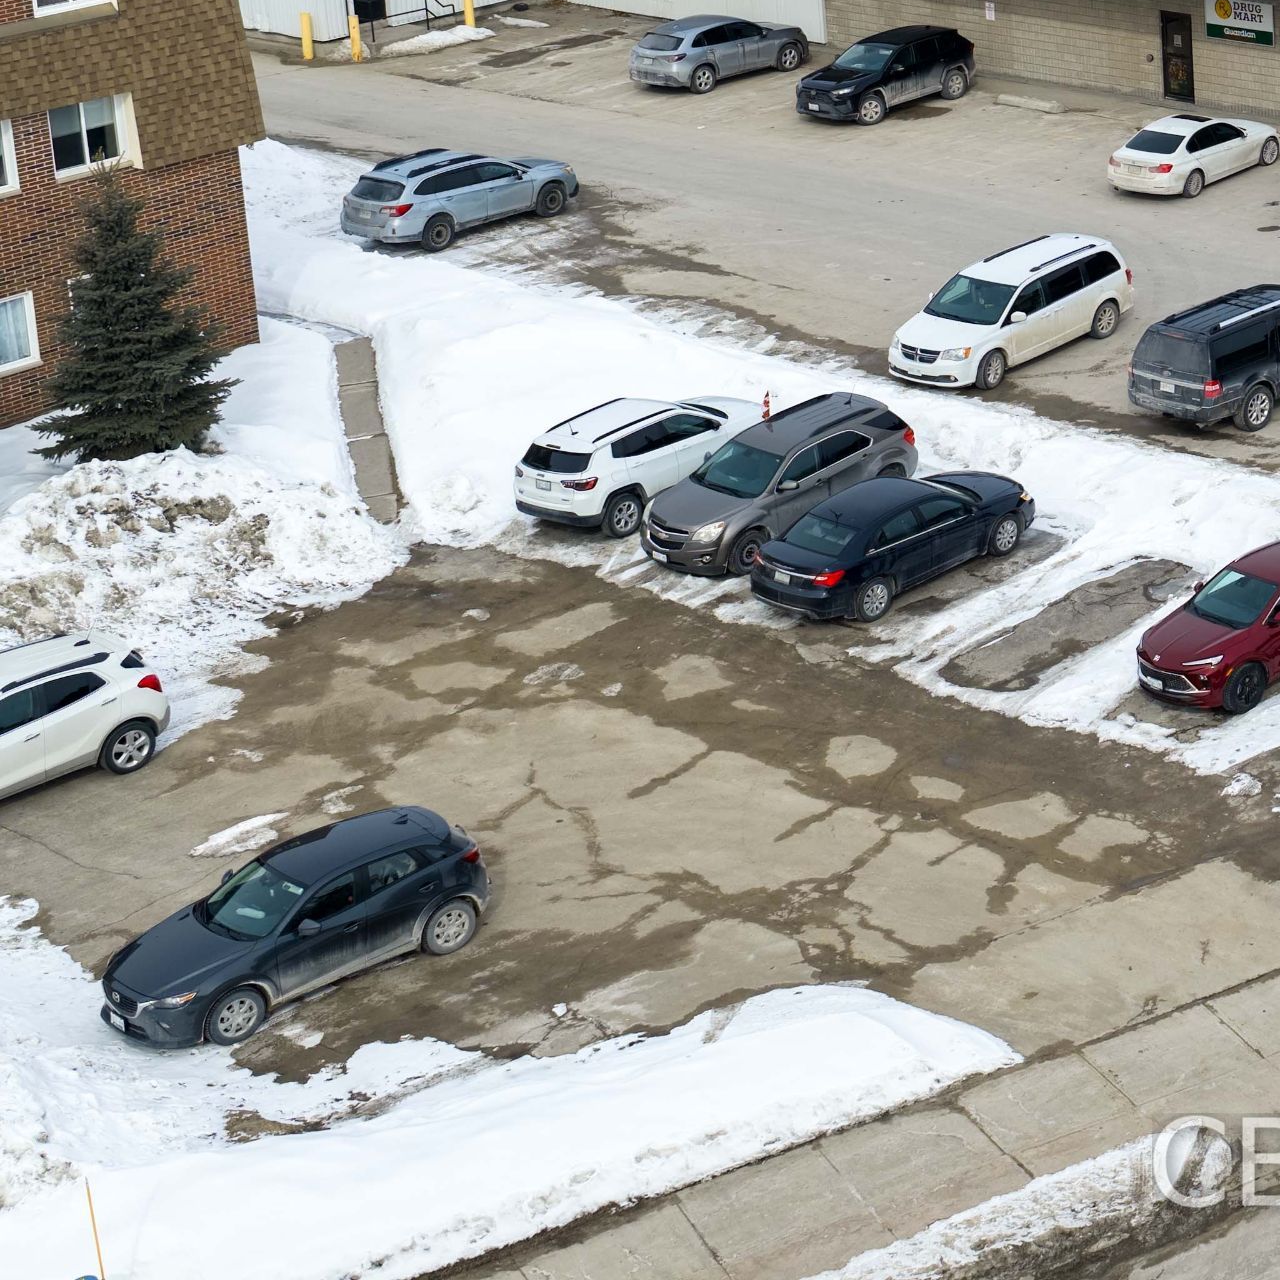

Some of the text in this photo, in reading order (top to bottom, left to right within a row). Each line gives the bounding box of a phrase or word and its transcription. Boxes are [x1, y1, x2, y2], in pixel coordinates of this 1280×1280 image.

[1233, 1, 1262, 14] DRUG
[1233, 10, 1264, 24] MART
[1223, 26, 1256, 39] Guardian
